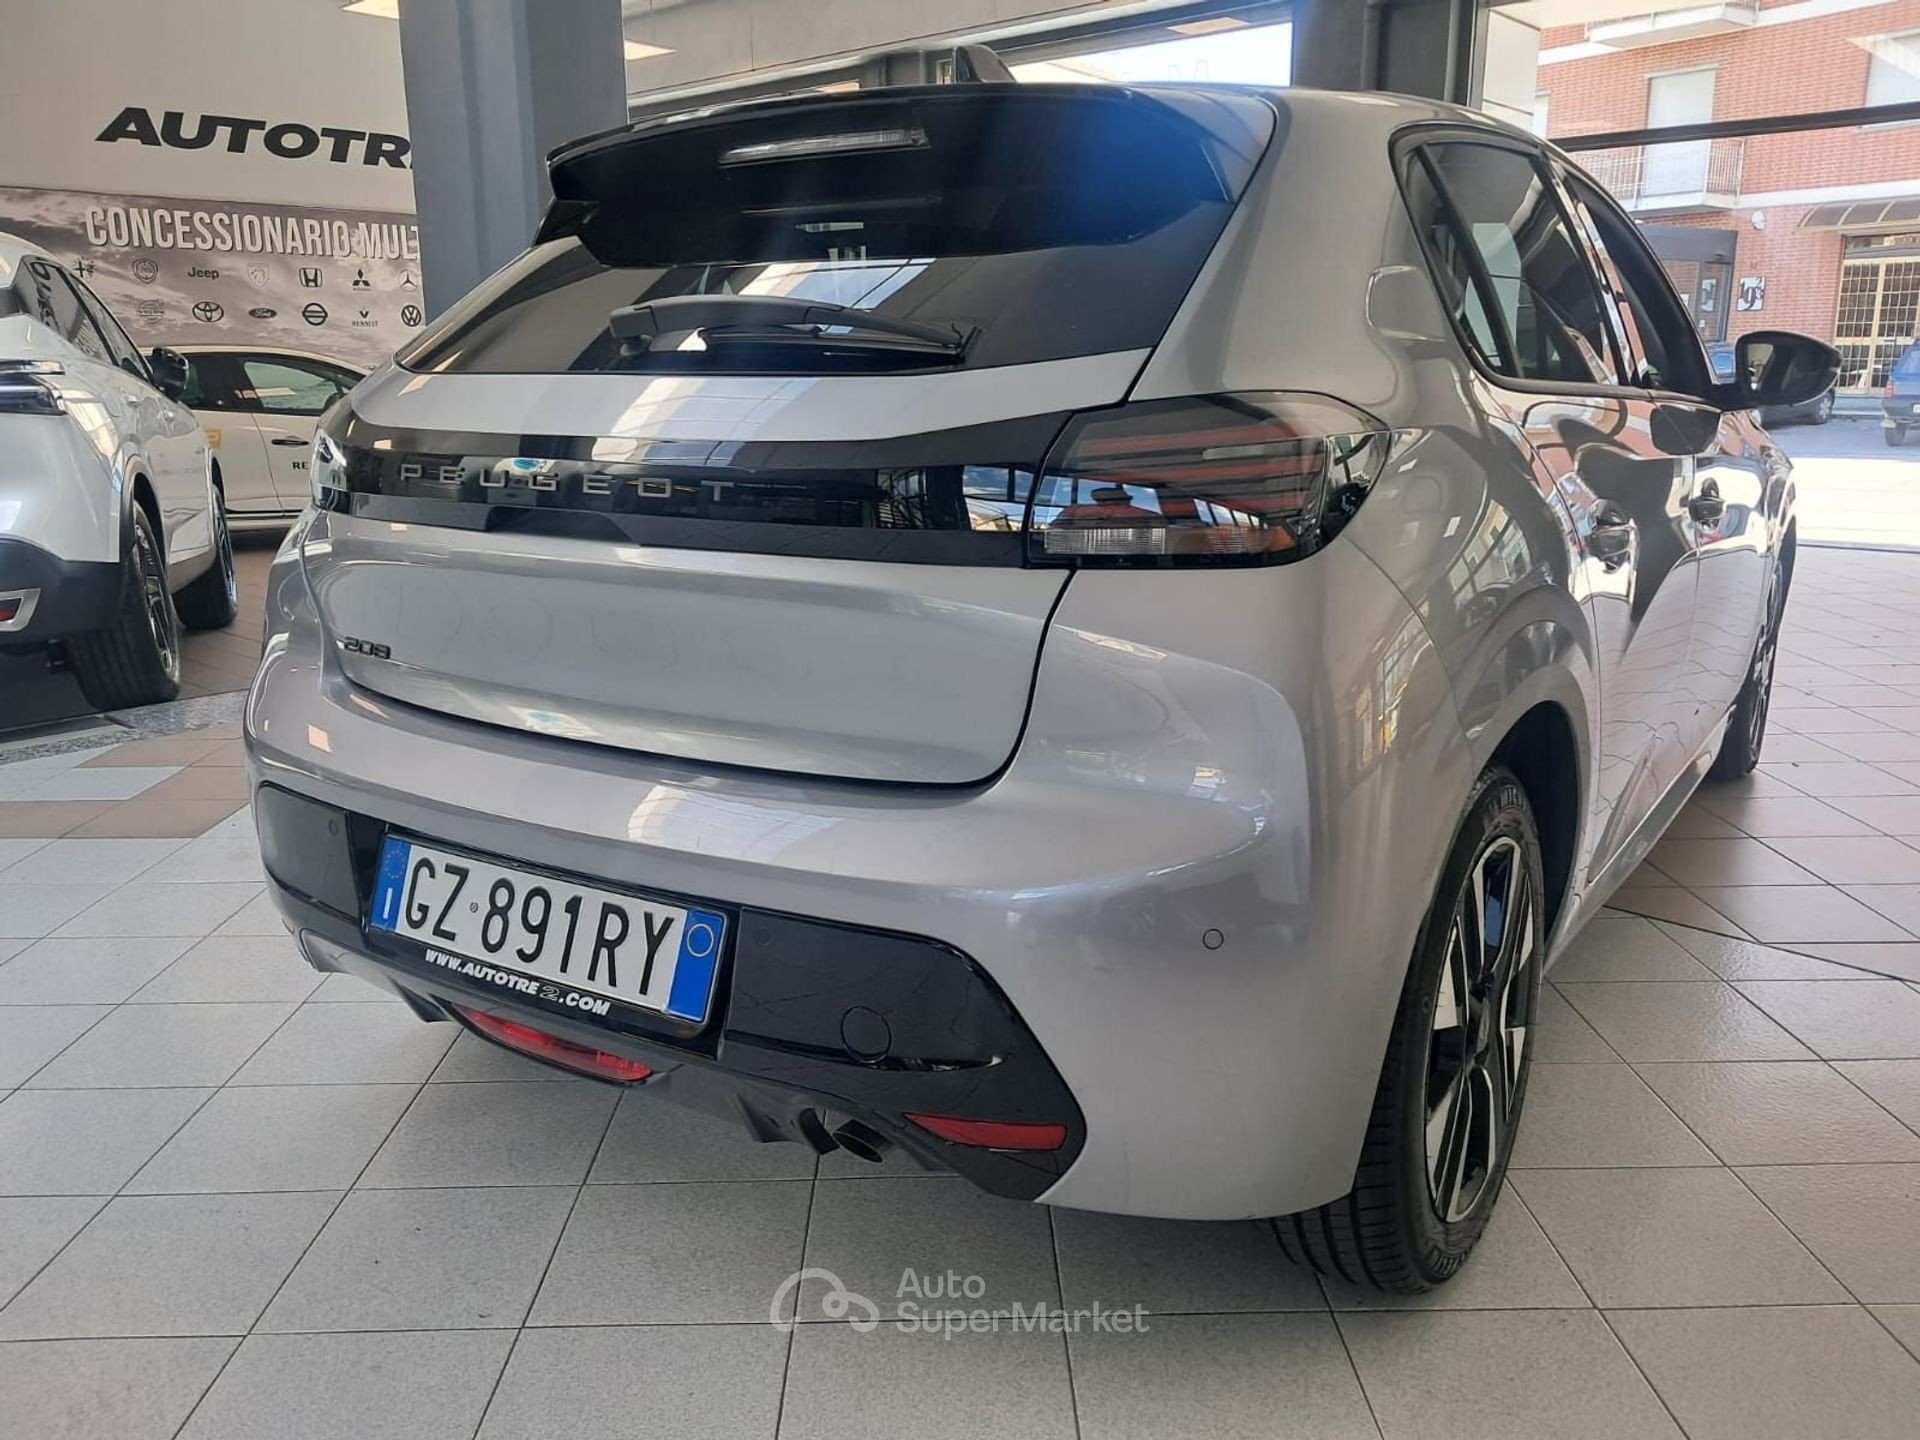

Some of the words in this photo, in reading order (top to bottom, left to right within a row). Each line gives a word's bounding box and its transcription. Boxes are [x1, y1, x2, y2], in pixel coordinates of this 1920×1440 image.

[95, 106, 413, 170] AUTOTR
[85, 205, 352, 258] CONCESSIONARIO
[187, 267, 220, 280] Jeep
[400, 463, 735, 502] PEUGEOT
[344, 636, 391, 660] 208
